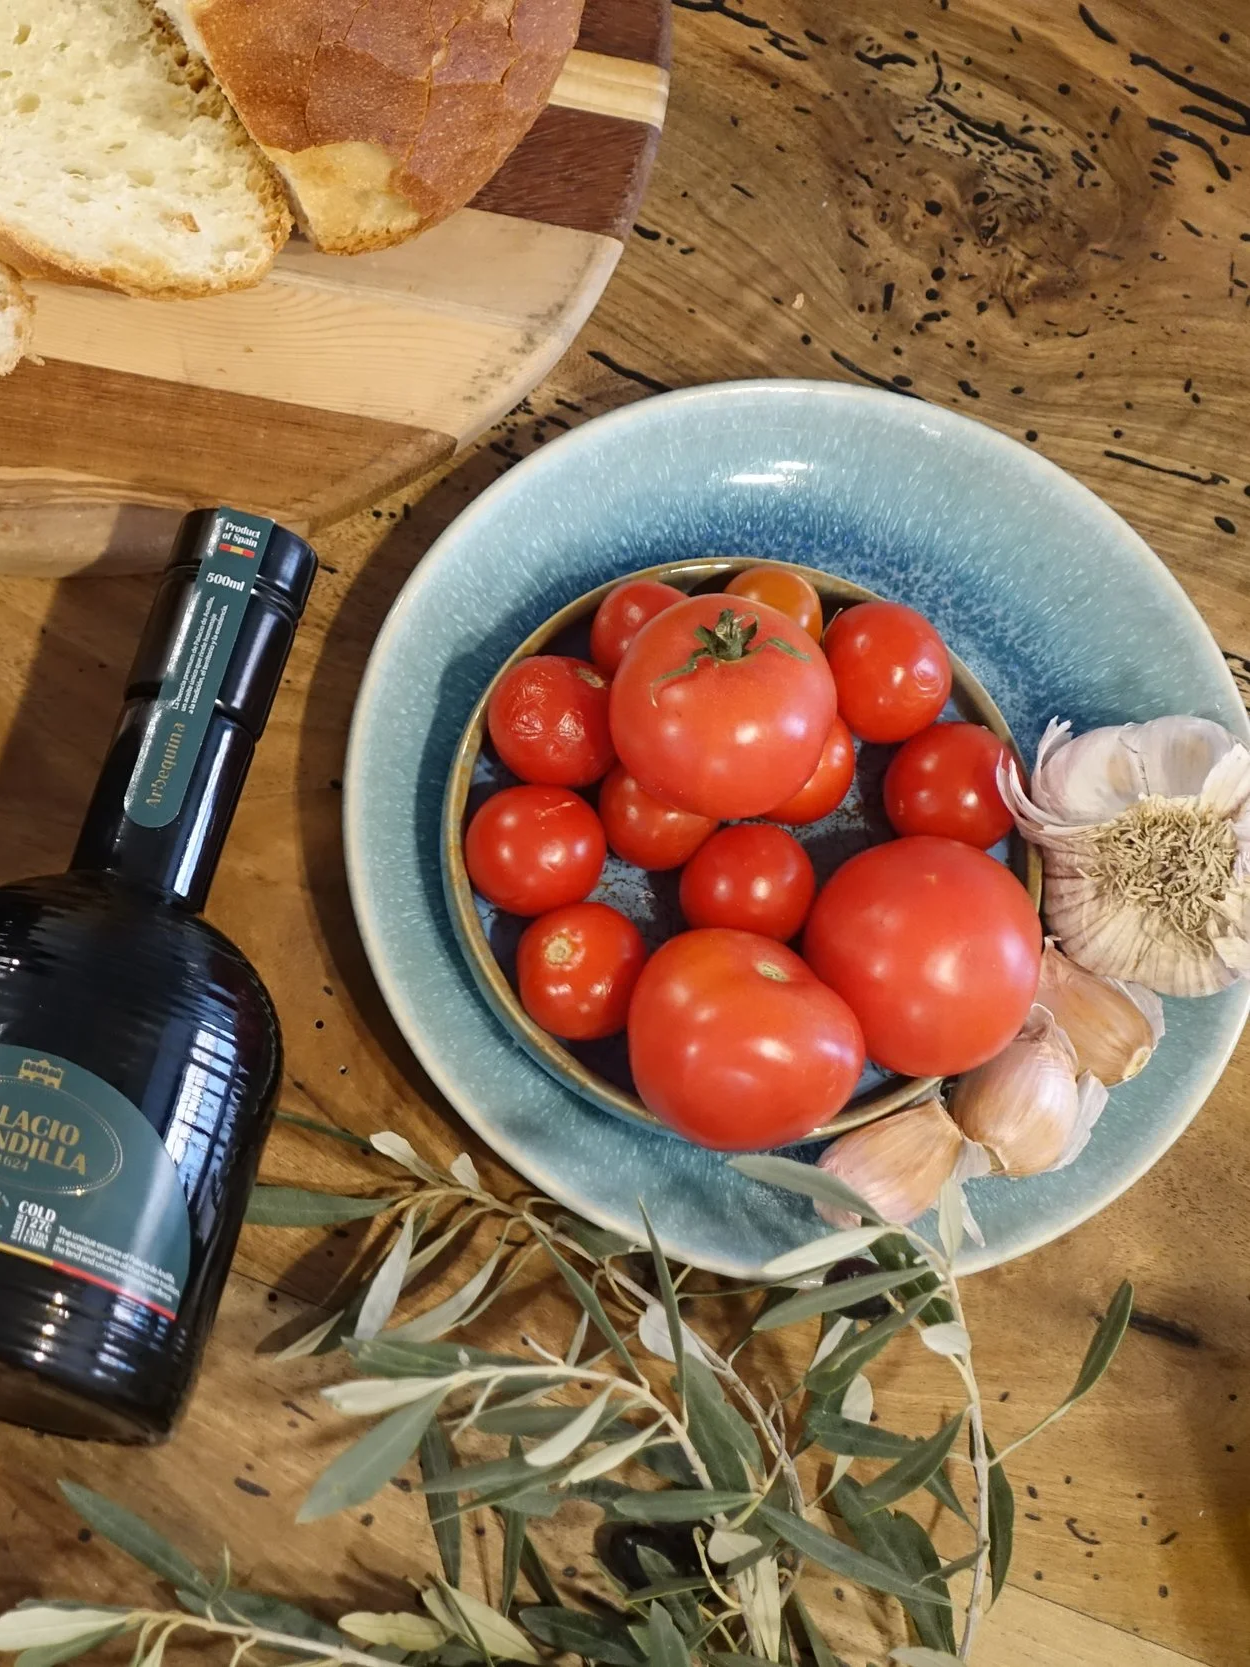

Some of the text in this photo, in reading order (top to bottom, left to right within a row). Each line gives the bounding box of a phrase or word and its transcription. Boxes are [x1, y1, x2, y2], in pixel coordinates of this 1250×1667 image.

[222, 532, 258, 548] of Spain
[225, 522, 261, 539] Product
[206, 572, 245, 592] 500ml
[201, 617, 207, 625] de
[194, 625, 204, 645] Palacio
[192, 645, 198, 653] de
[198, 641, 207, 657] rinde
[184, 653, 196, 680] premium
[195, 657, 203, 669] que
[184, 685, 193, 703] aceite
[144, 721, 185, 808] Arbequina
[18, 1200, 56, 1223] COLD
[57, 1225, 72, 1237] The
[71, 1231, 96, 1247] unique
[96, 1242, 122, 1257] essence
[52, 1243, 64, 1254] the
[64, 1247, 81, 1260] land
[81, 1255, 95, 1265] and
